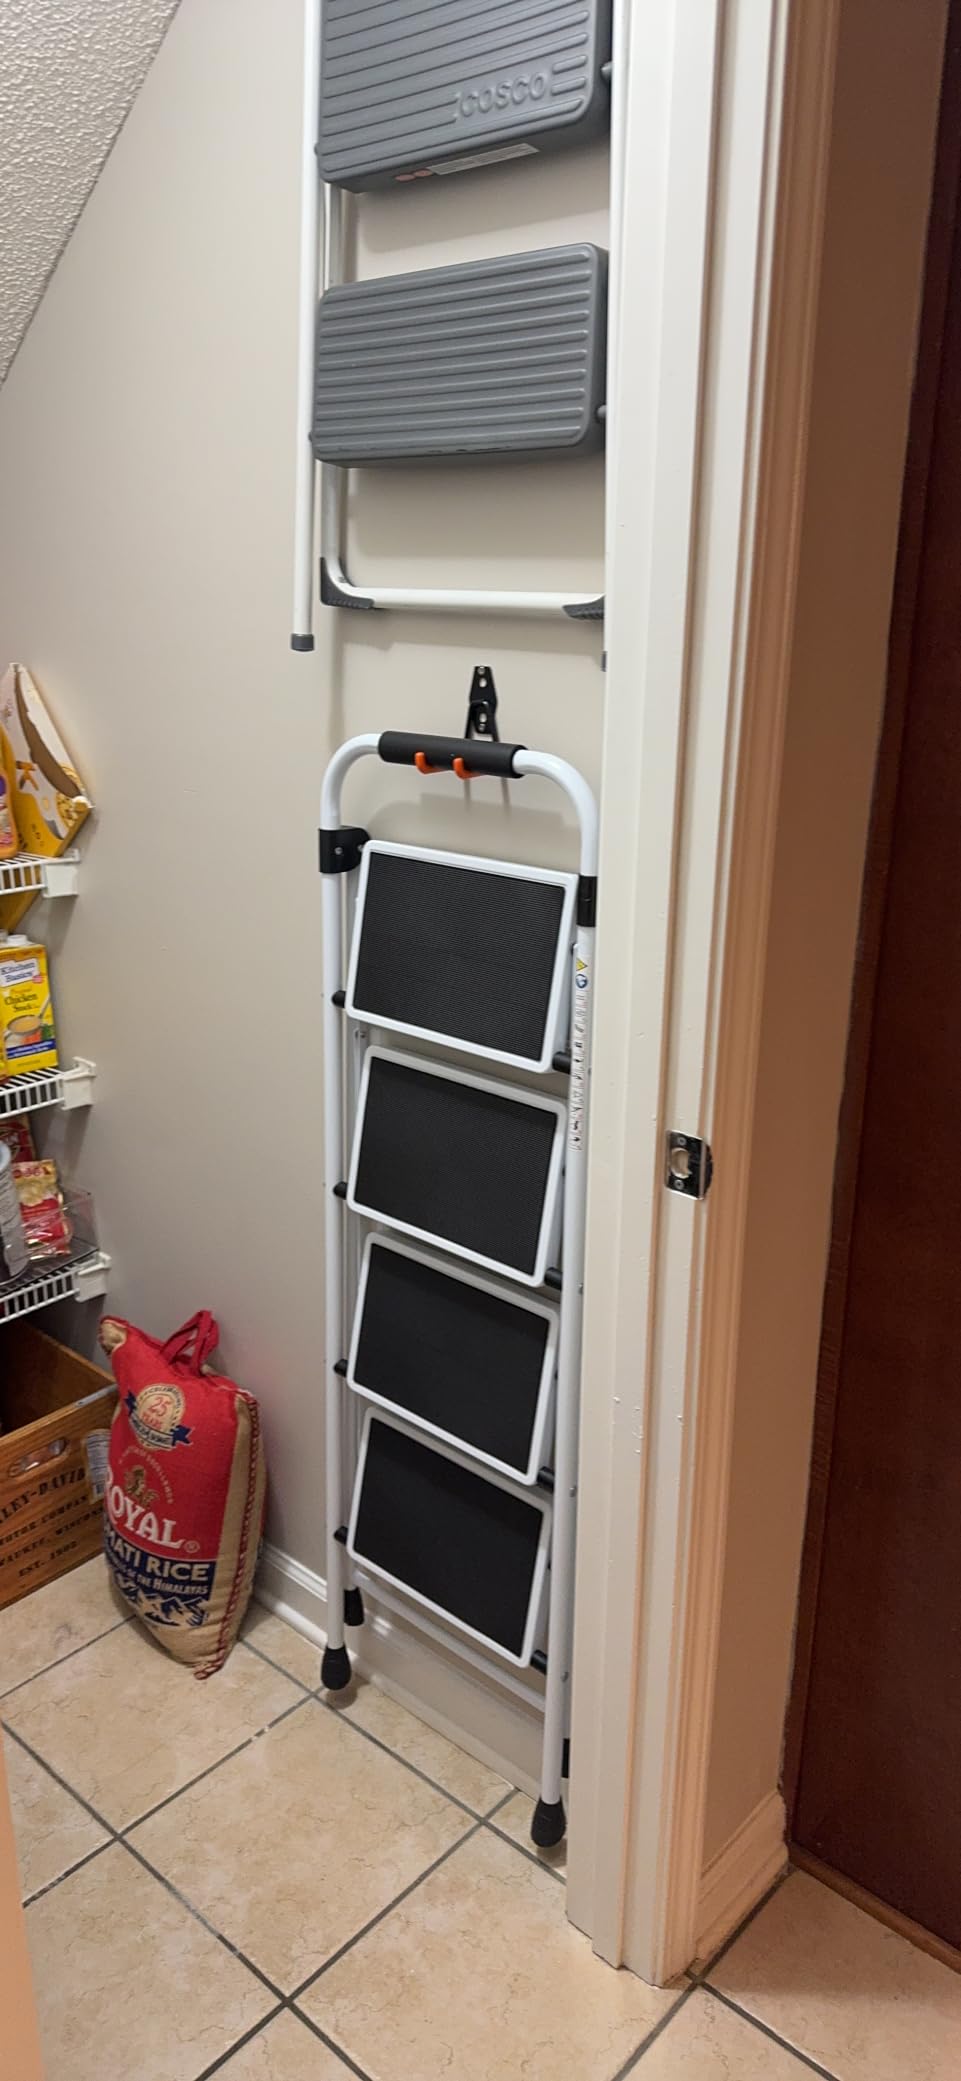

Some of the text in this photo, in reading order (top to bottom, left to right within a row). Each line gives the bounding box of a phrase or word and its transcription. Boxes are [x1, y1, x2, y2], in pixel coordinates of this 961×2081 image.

[460, 73, 546, 118] COSCO
[5, 994, 38, 1006] Chicken
[148, 1396, 172, 1417] 25
[0, 1467, 86, 1524] LEY-DAVID
[41, 1494, 89, 1523] COMPAN
[104, 1524, 141, 1567] MATI
[146, 1556, 211, 1581] RICE
[152, 1577, 209, 1595] HIMALAYAS
